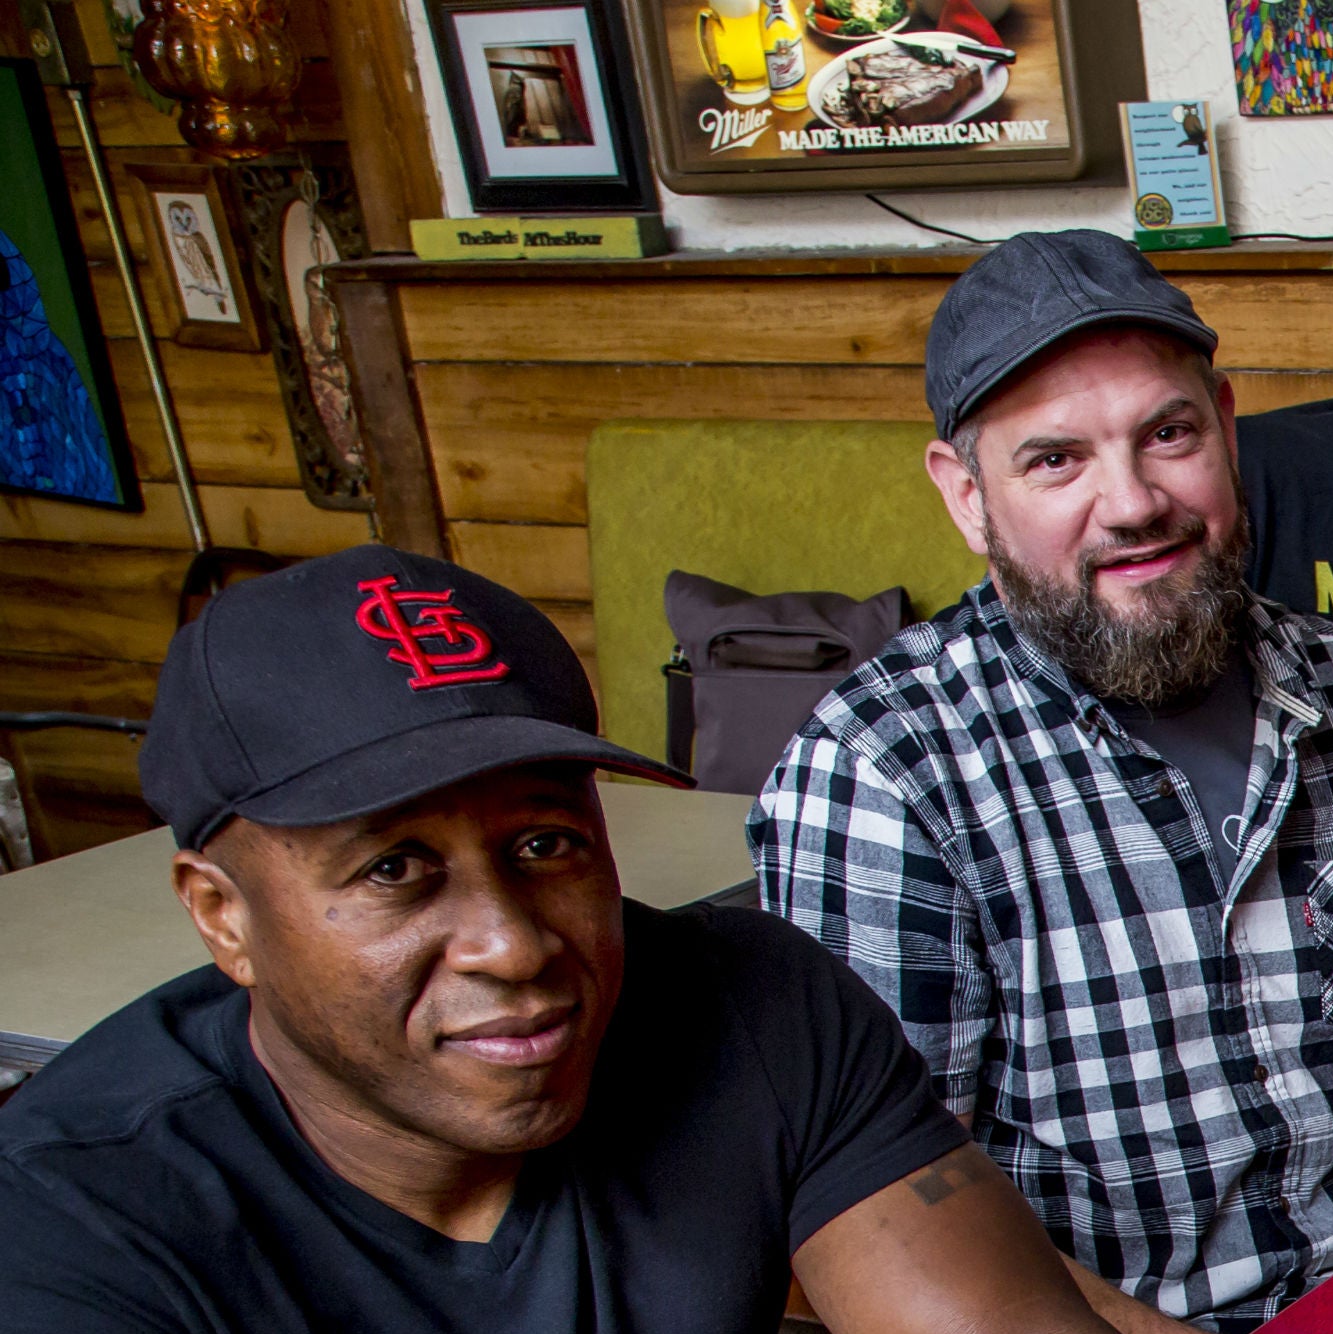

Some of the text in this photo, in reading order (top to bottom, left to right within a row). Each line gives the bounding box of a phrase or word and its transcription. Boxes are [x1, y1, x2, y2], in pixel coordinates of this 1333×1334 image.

[699, 108, 774, 150] Miller
[778, 120, 1050, 150] MADE THE AMERICAN WAY
